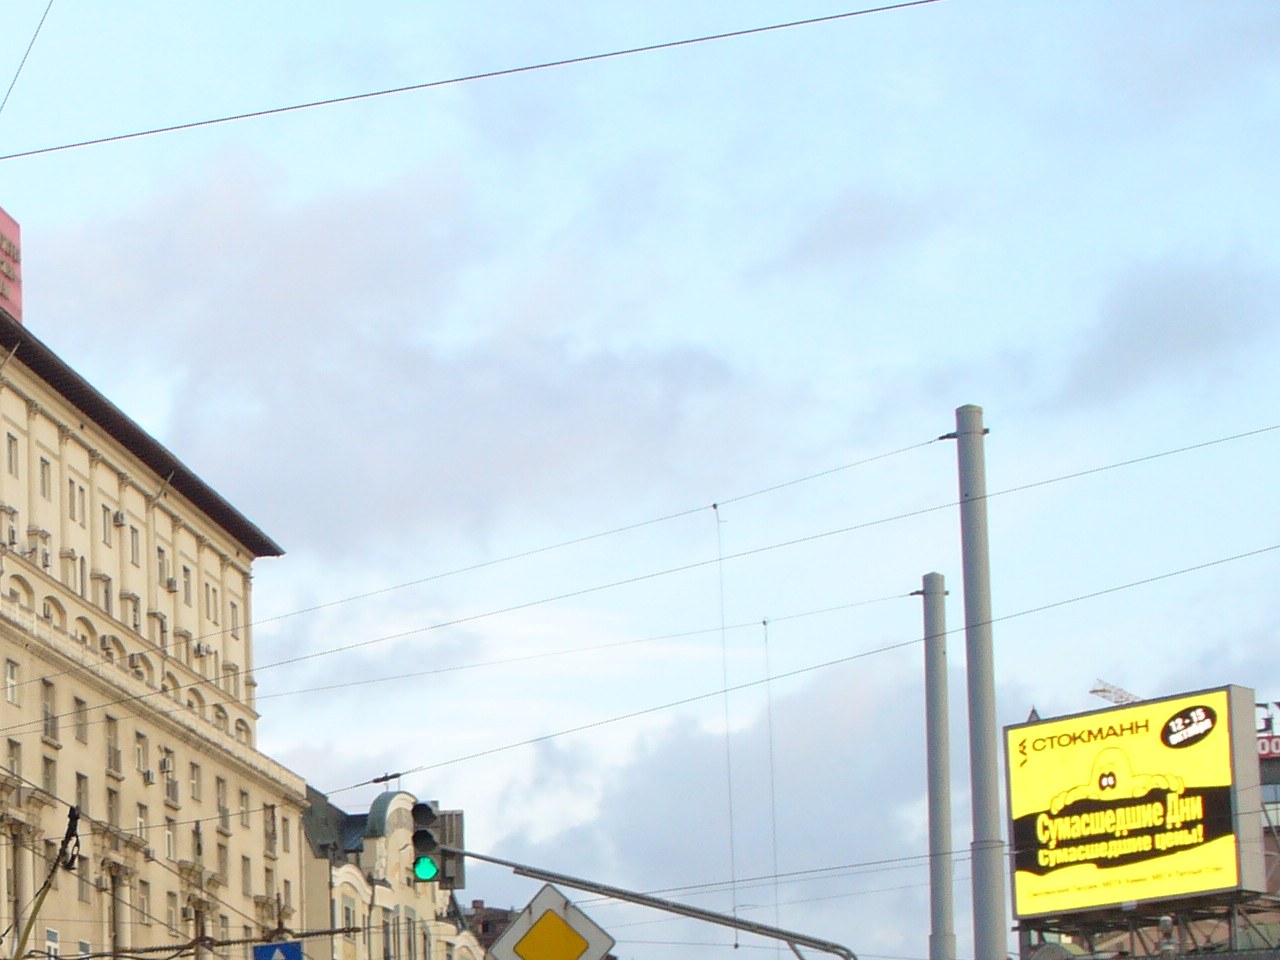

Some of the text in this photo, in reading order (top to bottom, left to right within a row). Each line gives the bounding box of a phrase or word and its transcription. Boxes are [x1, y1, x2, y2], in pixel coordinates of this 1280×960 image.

[1032, 719, 1149, 752] СТОКМАНН
[1036, 793, 1203, 848] Сумасшедшие Дни
